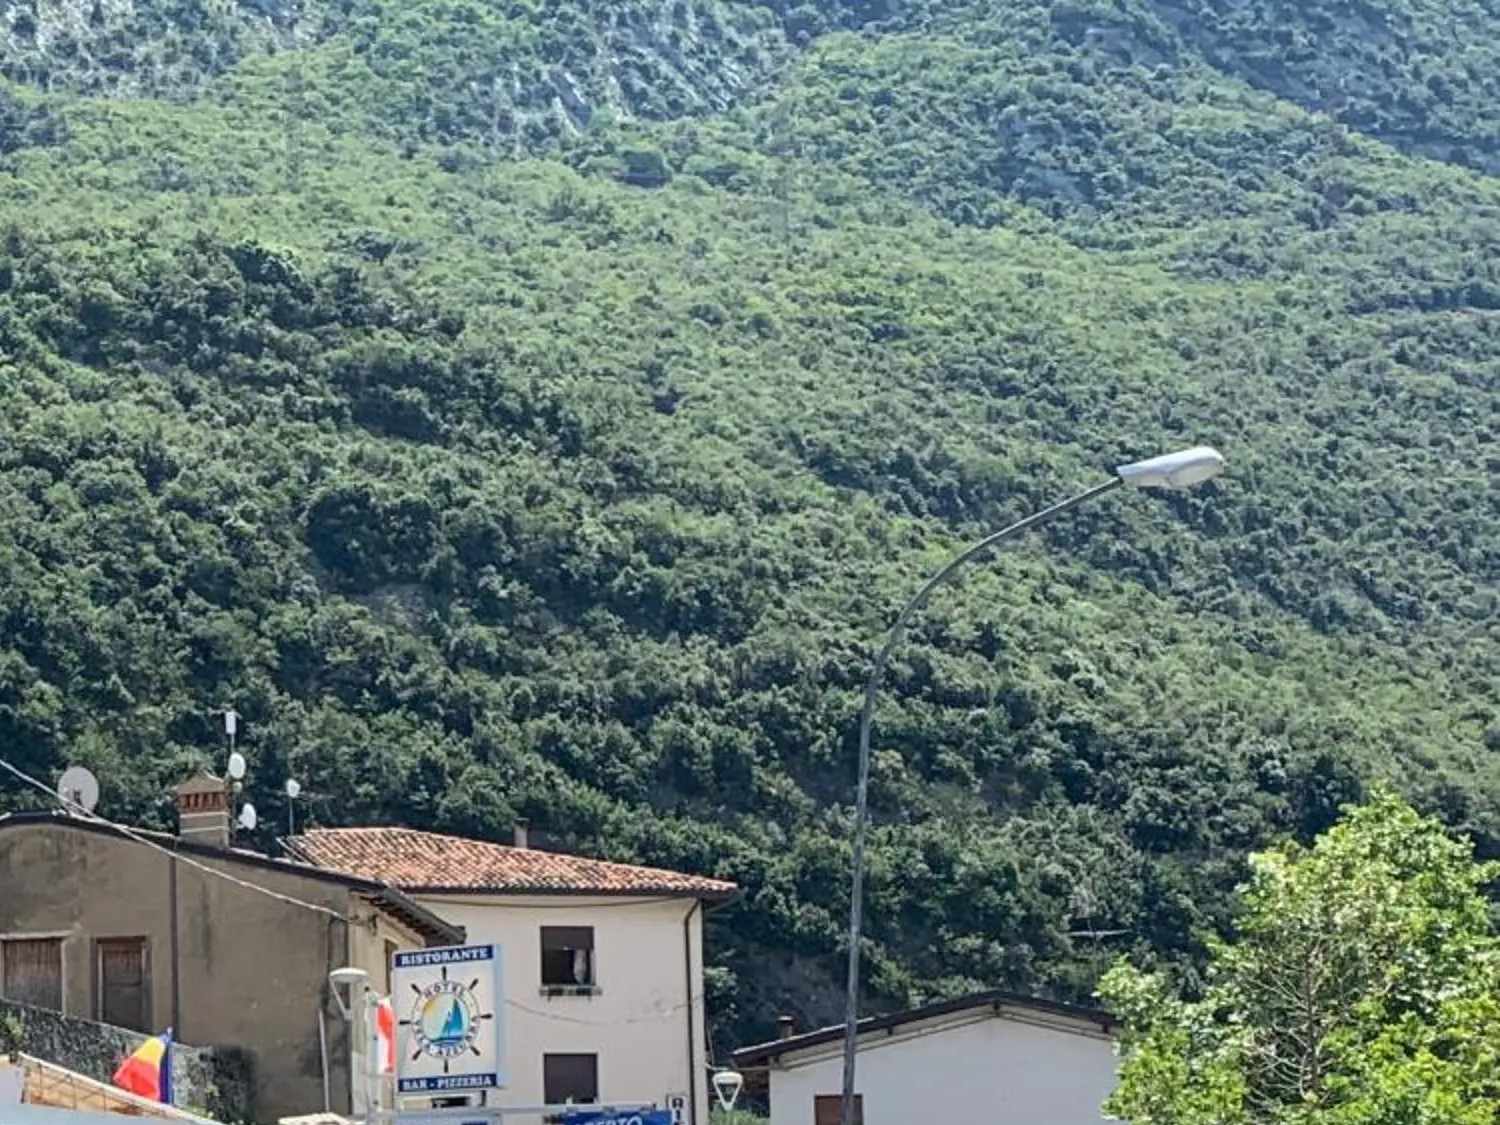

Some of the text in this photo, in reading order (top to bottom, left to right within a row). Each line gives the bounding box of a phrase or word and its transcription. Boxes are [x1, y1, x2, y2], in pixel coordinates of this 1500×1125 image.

[400, 949, 489, 965] RISTORANTE
[403, 1081, 428, 1089] BAR
[437, 1076, 492, 1088] PIZZERIA
